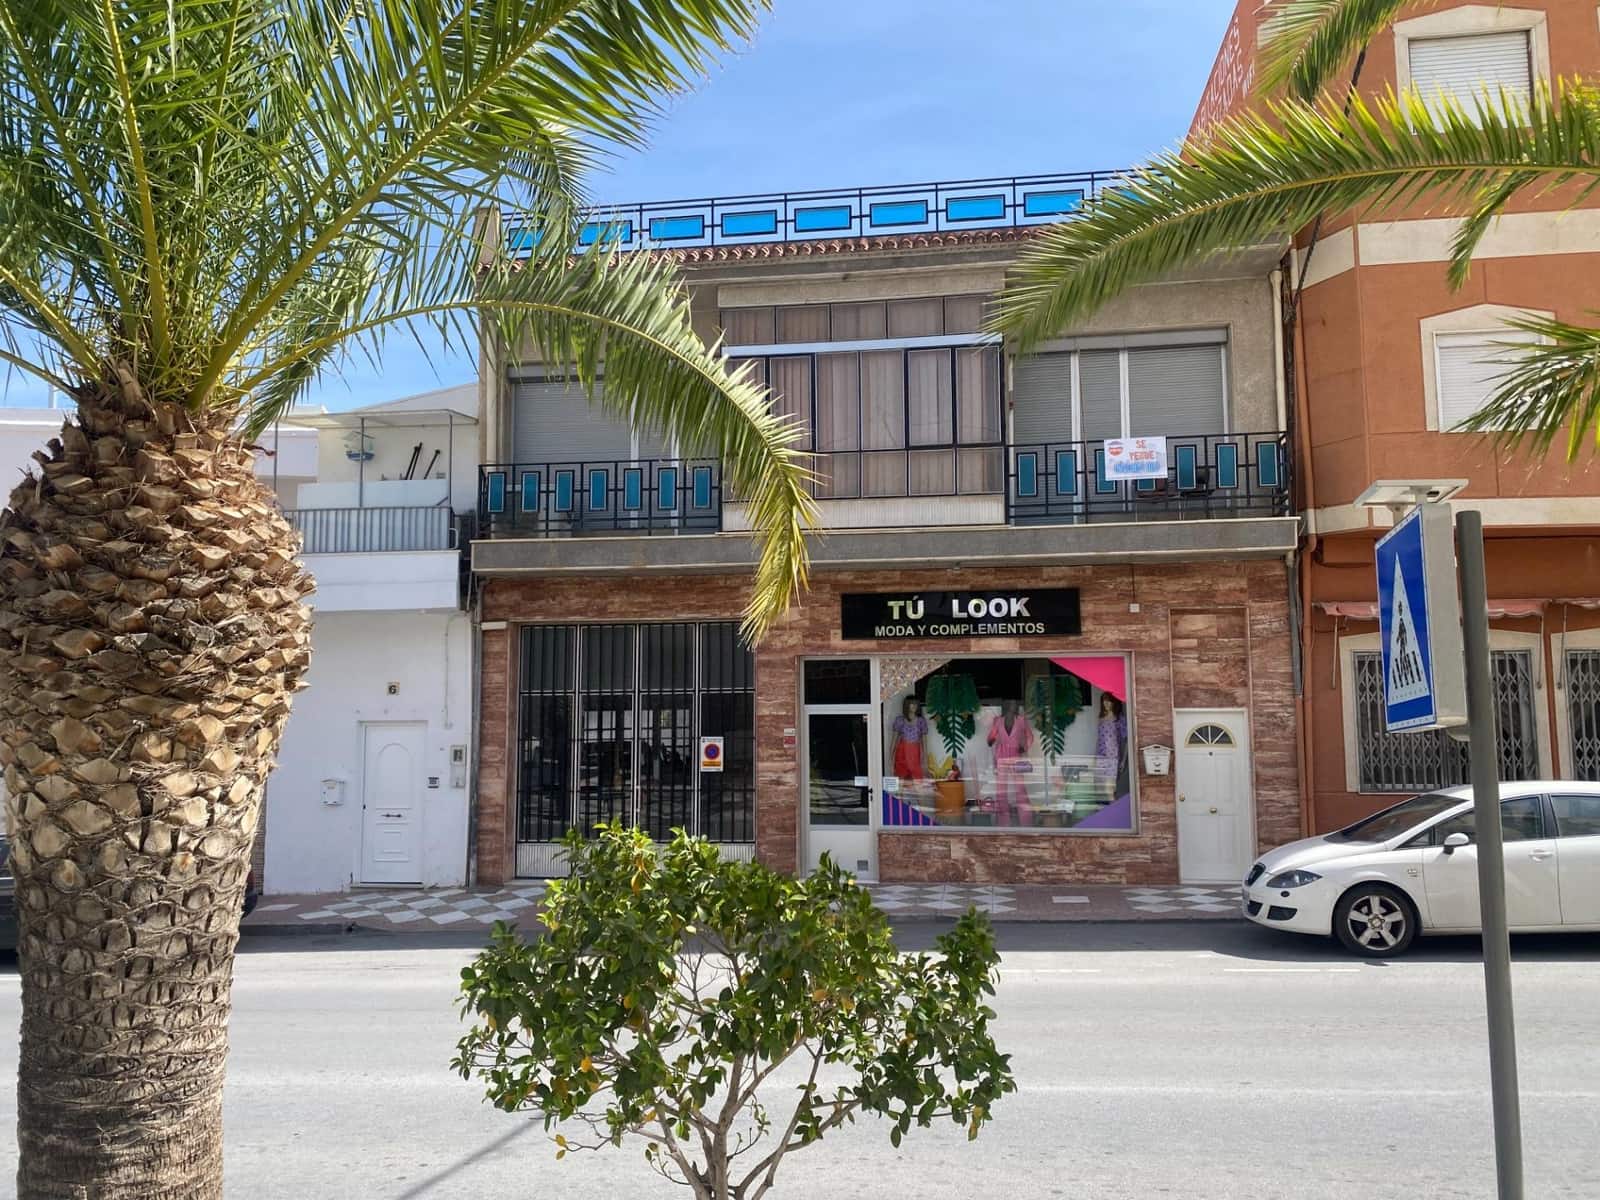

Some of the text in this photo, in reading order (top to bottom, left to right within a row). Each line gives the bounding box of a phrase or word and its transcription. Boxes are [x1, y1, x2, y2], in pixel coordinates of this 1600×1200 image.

[887, 595, 1031, 620] TÚ LOOK
[874, 622, 1046, 637] MODA Y COMPLEMENTOS
